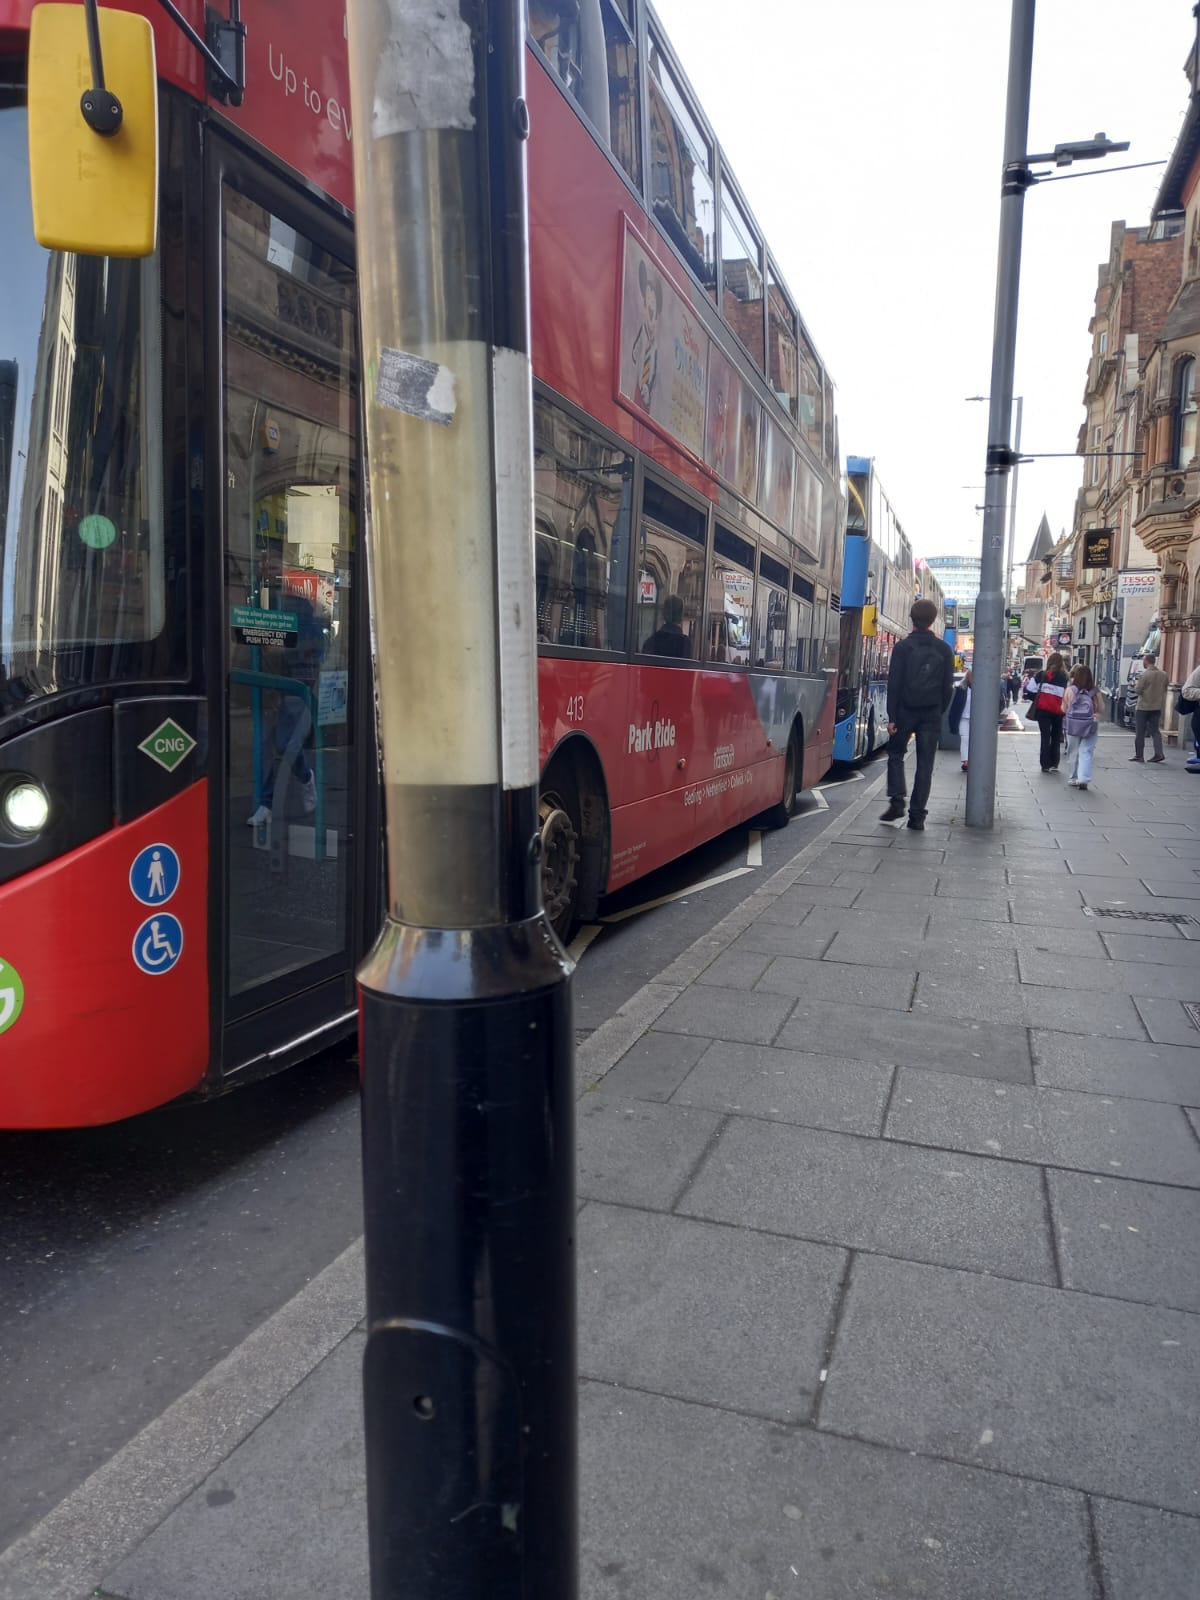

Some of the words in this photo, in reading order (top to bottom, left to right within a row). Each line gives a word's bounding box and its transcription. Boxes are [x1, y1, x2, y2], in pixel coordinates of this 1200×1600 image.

[268, 42, 297, 97] Up
[302, 76, 321, 114] to
[1122, 575, 1155, 583] TESCO
[1121, 586, 1154, 595] express
[566, 695, 584, 721] 413
[154, 737, 185, 754] CNG
[628, 721, 653, 754] Park
[654, 718, 676, 749] Ride
